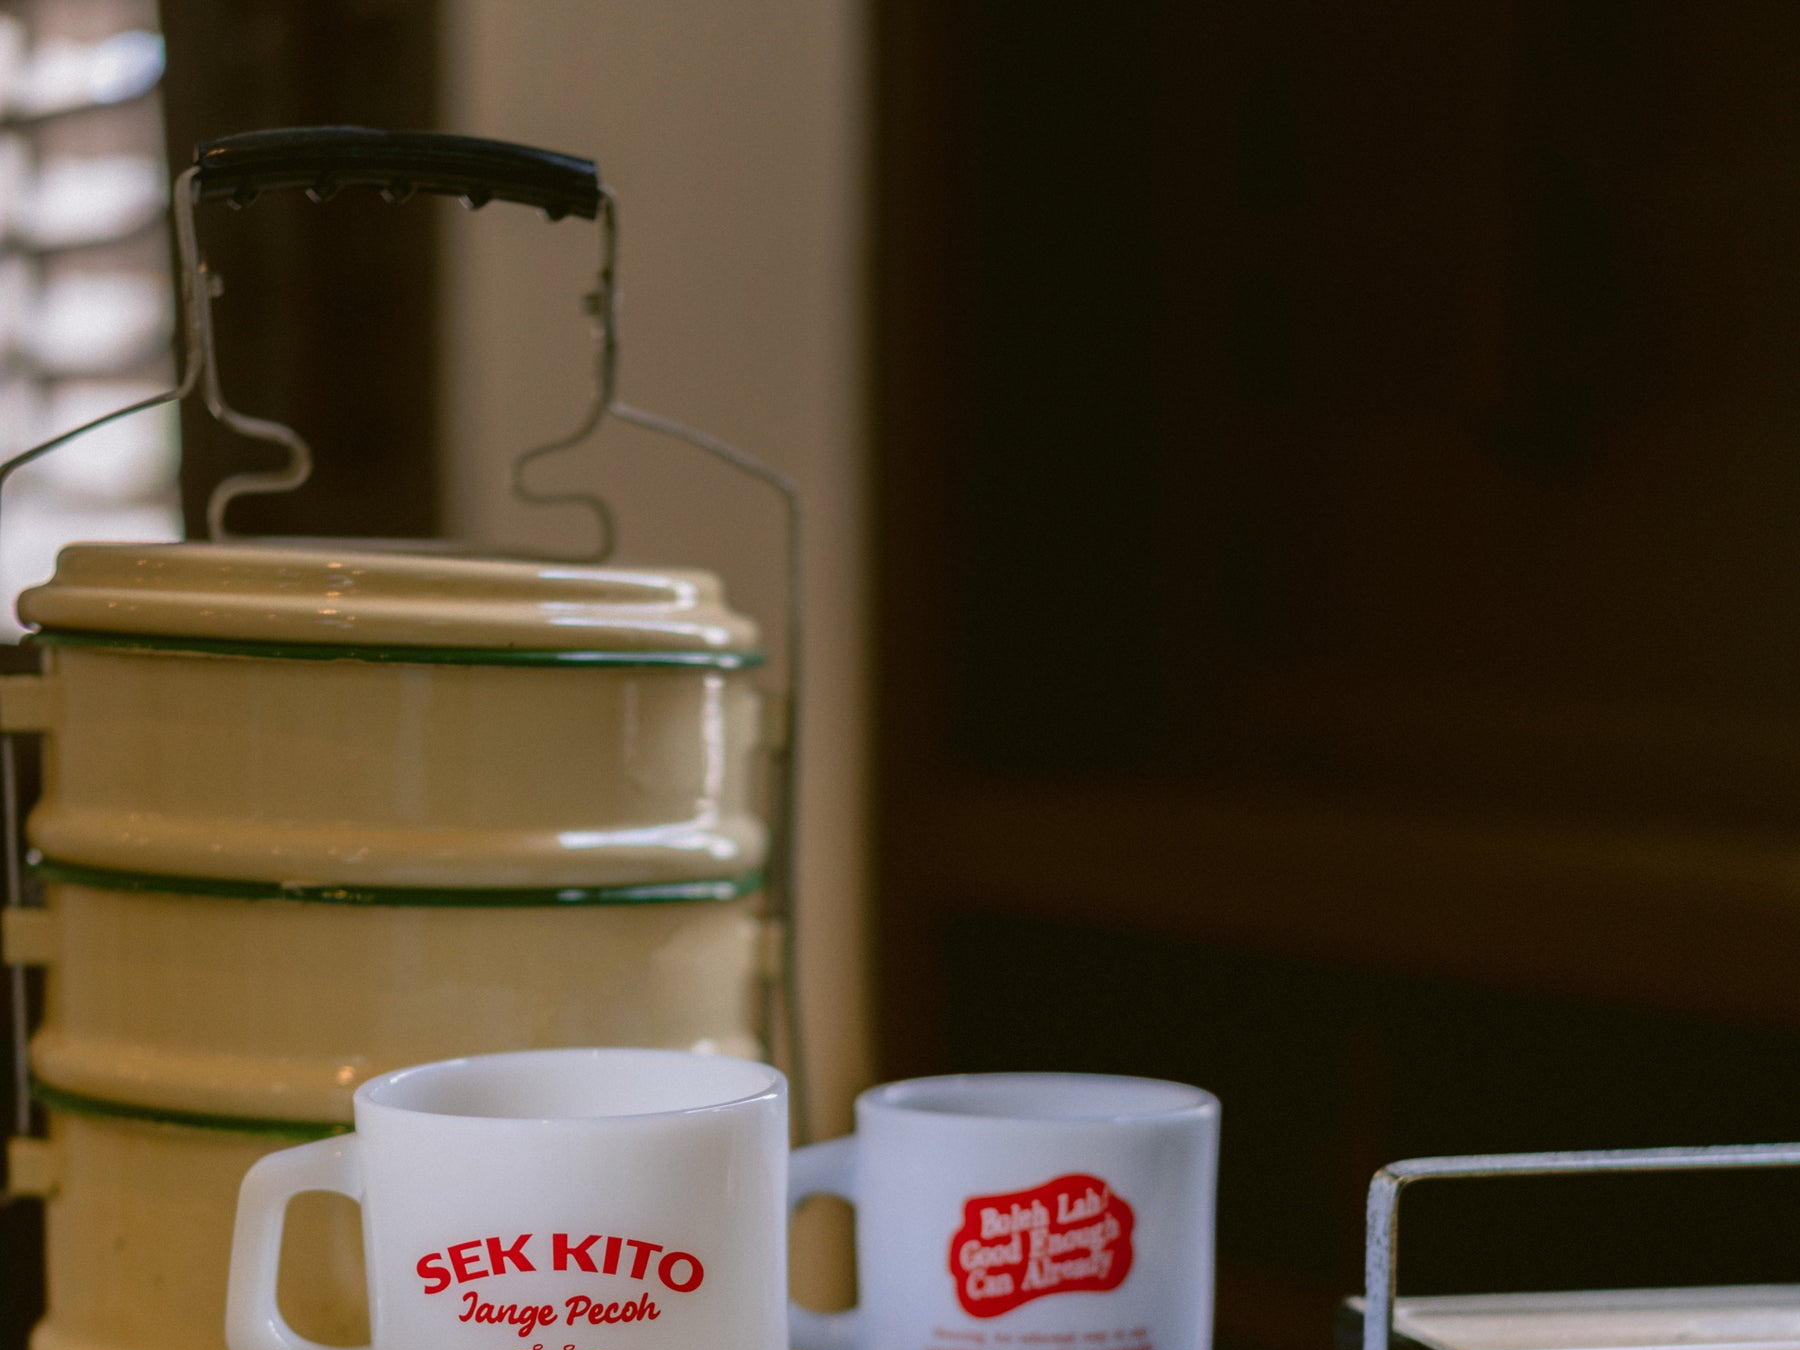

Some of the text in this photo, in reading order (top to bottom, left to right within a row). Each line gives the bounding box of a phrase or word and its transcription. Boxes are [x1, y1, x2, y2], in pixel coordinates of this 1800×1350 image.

[416, 1233, 704, 1294] SEK KITO
[959, 1212, 1121, 1271] Good Enough
[966, 1250, 1114, 1301] Can Already
[565, 1292, 661, 1326] Pecoh
